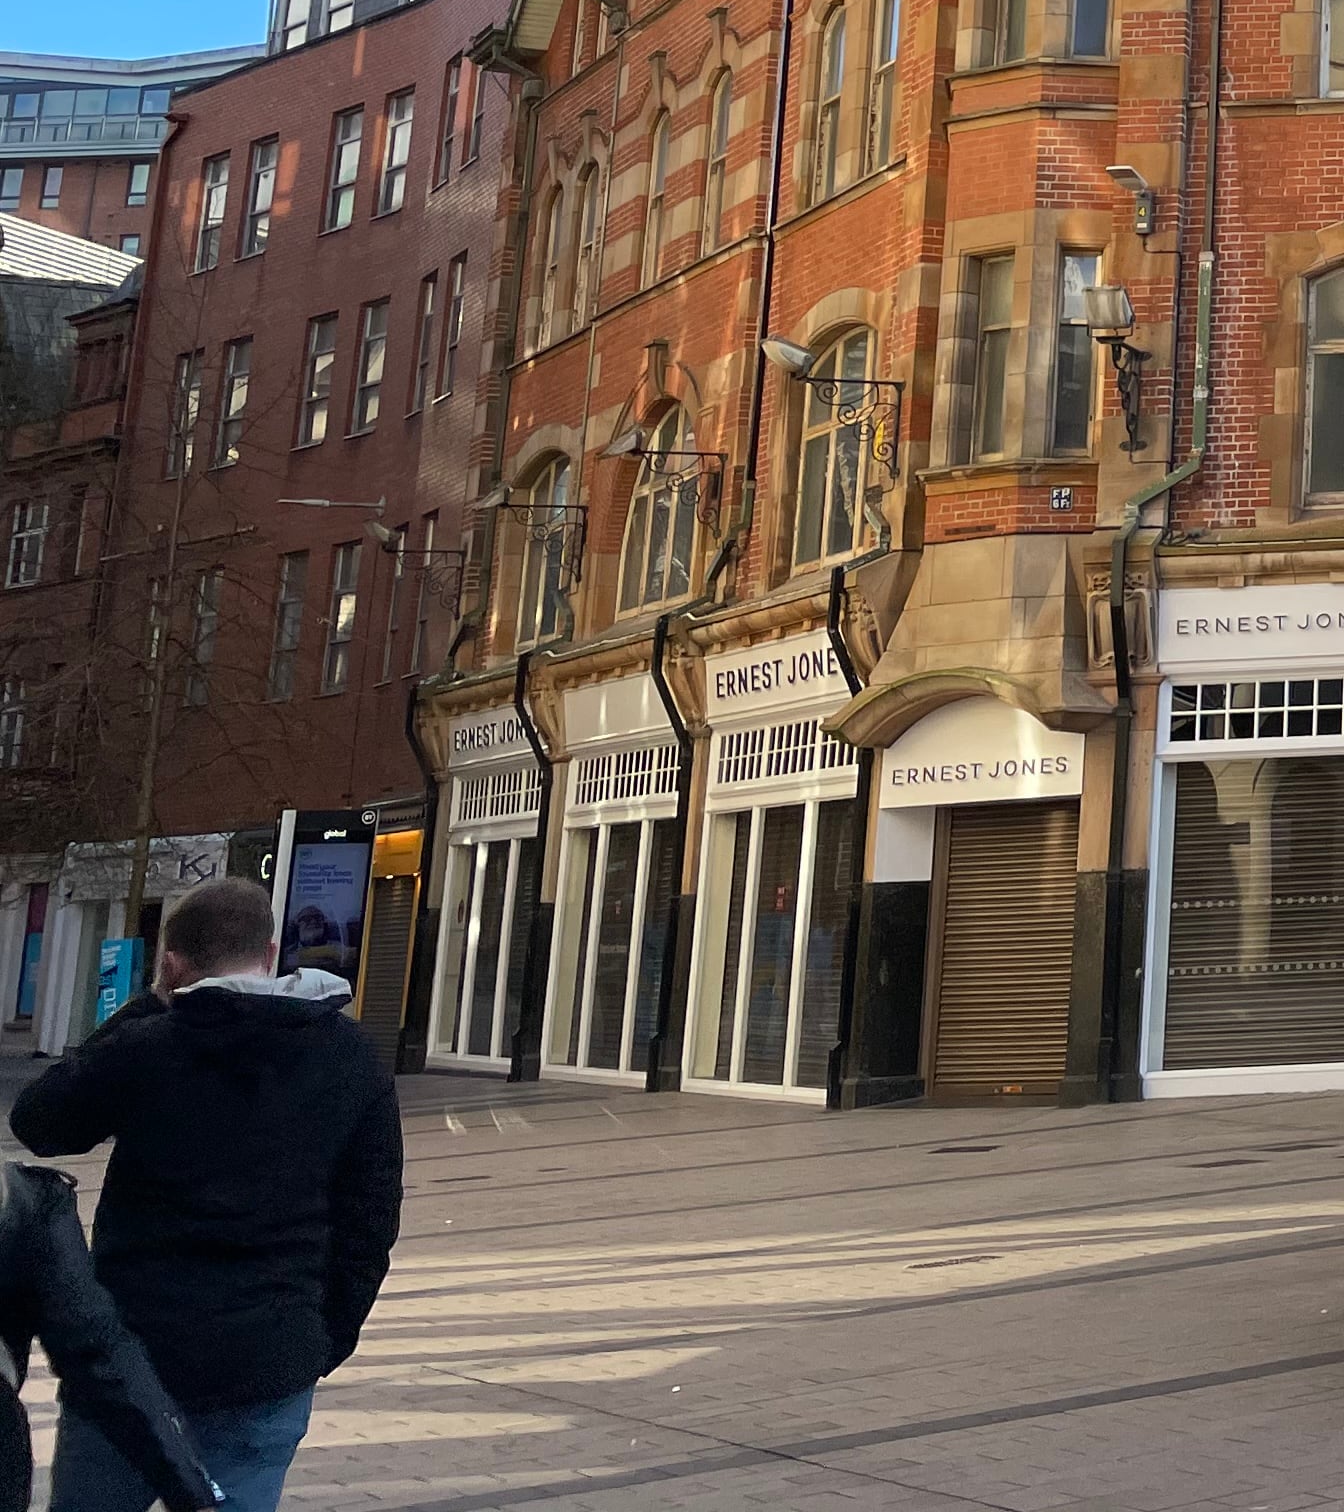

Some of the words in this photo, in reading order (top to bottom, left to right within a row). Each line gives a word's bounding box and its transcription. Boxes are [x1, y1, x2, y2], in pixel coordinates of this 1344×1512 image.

[1176, 615, 1288, 635] ERNEST
[716, 659, 783, 698] ERNEST
[787, 647, 838, 684] JONE
[454, 722, 497, 752] ERNEST
[500, 718, 524, 744] JON
[892, 763, 983, 786] ERNEST
[988, 756, 1068, 778] JONES
